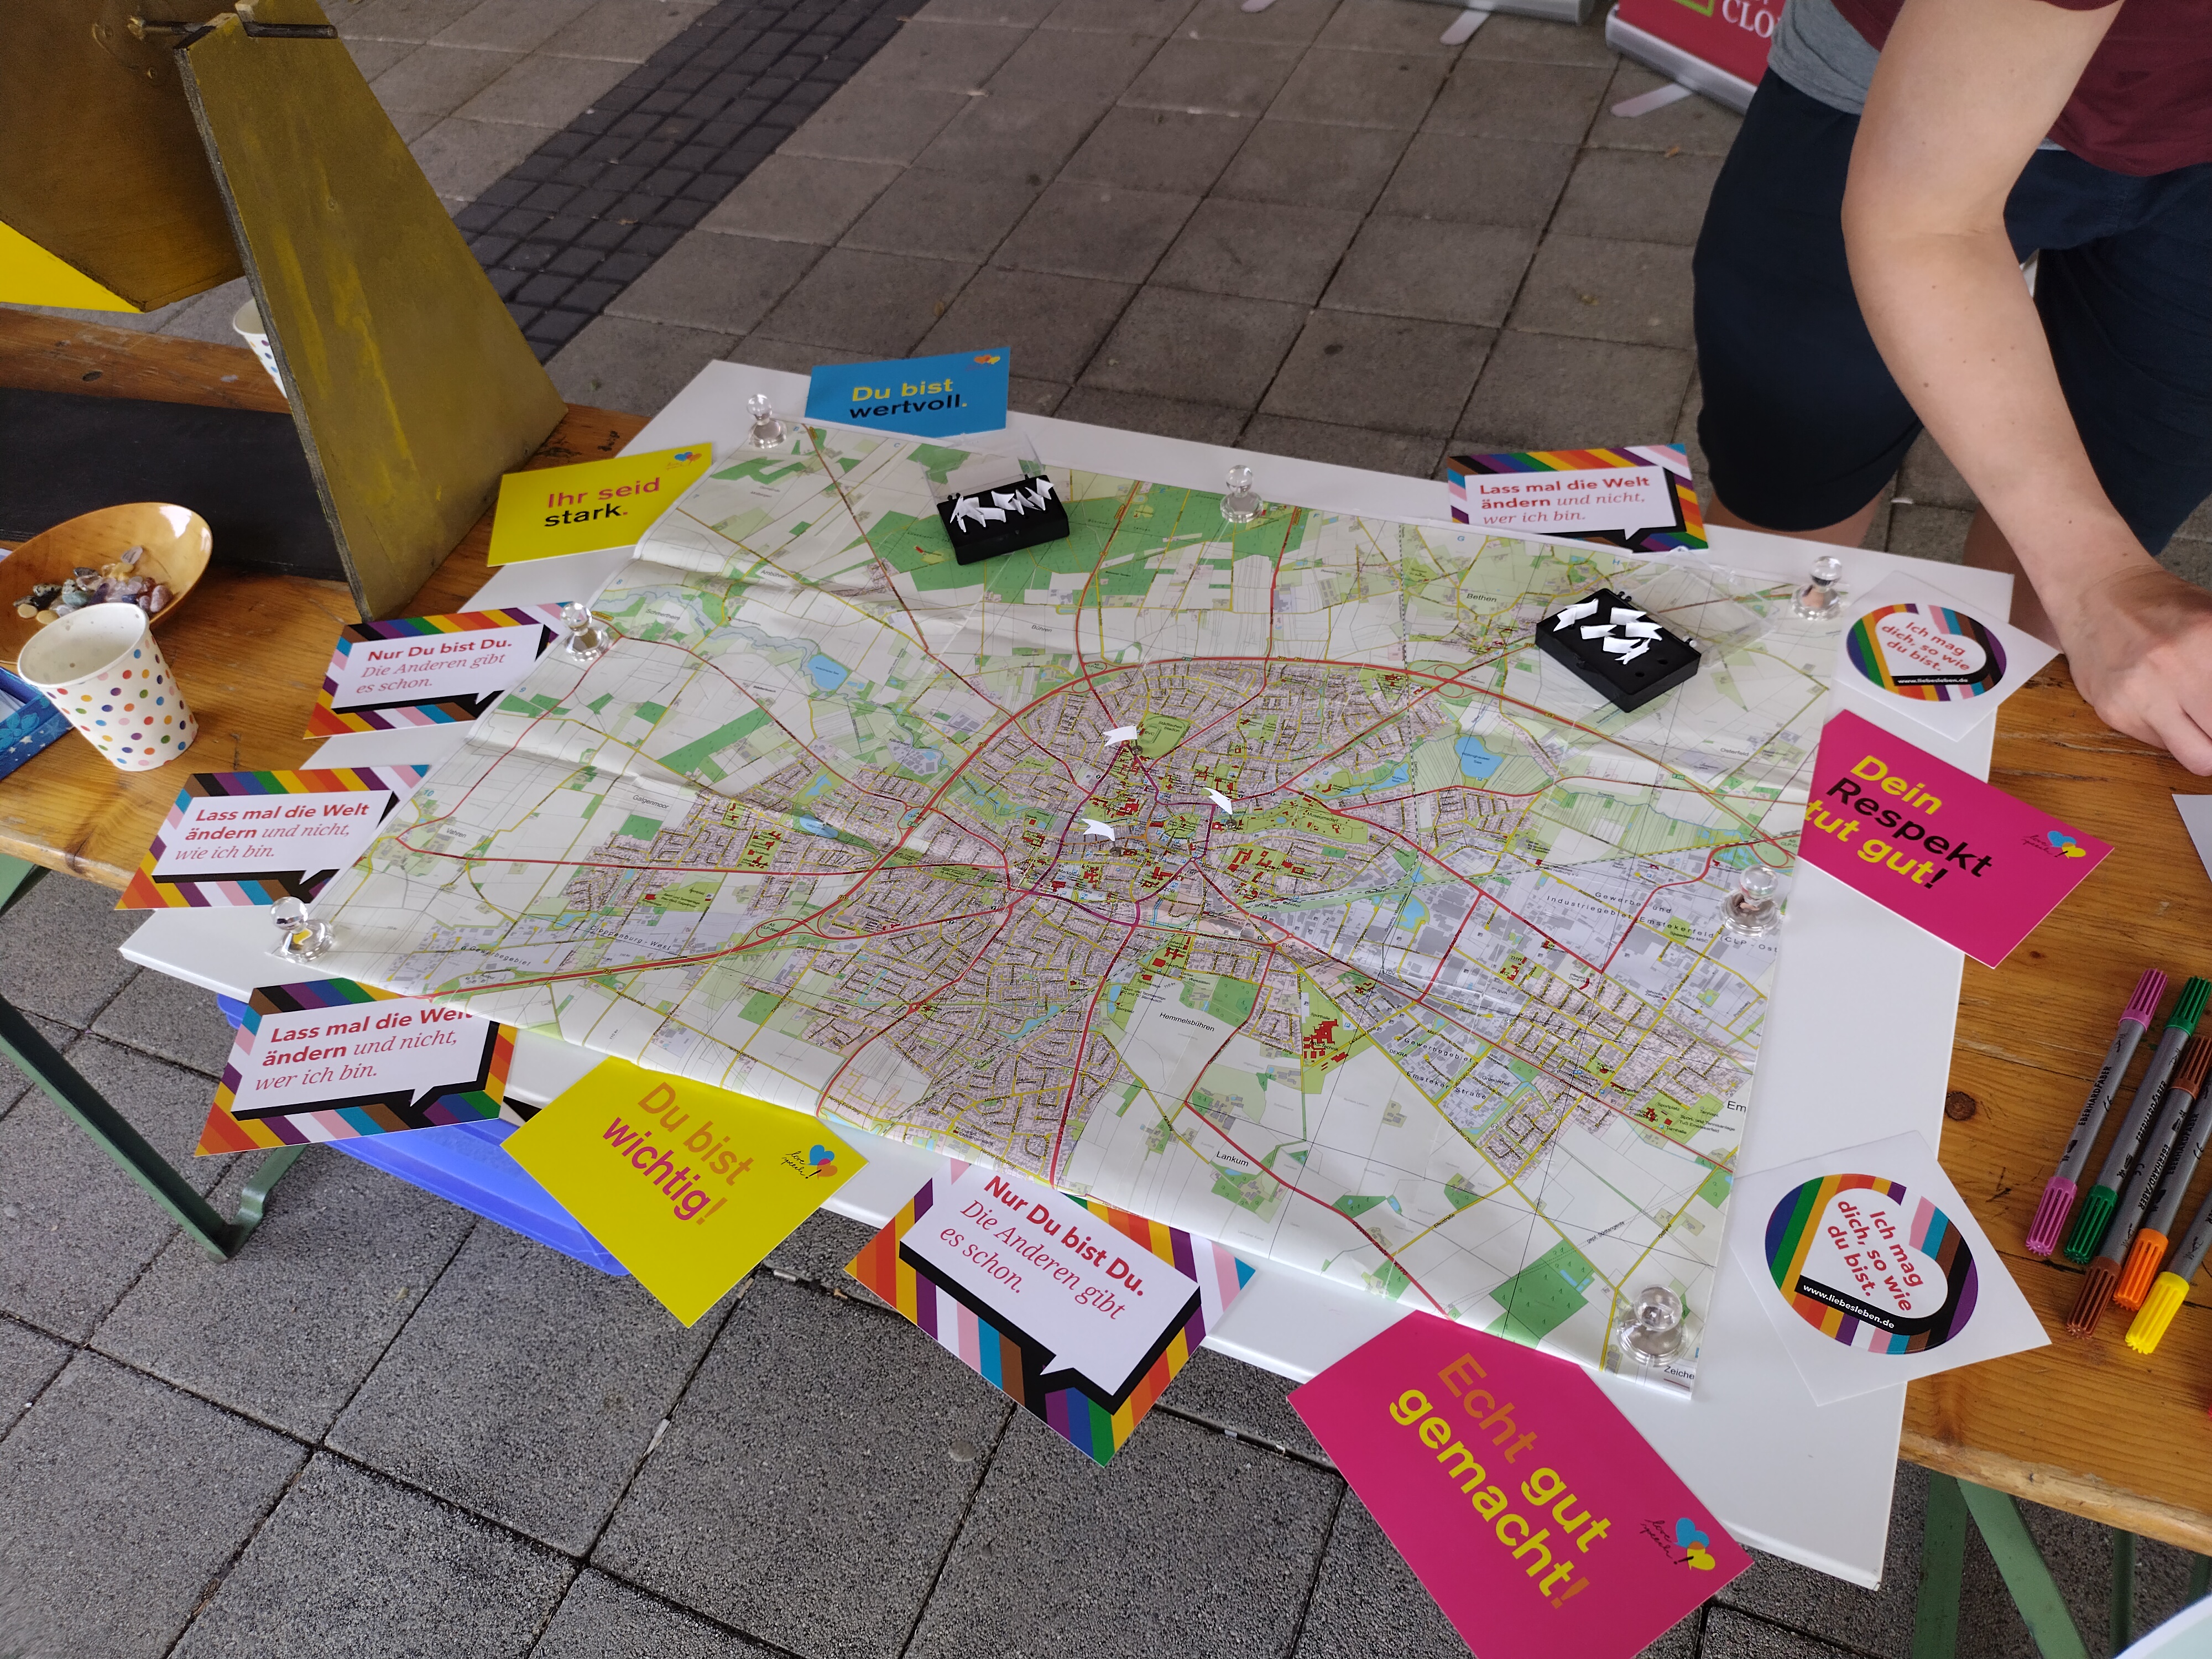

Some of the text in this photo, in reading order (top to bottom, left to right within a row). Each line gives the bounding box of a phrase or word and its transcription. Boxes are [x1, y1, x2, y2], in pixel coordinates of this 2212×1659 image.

[1722, 0, 1780, 38] CLO
[852, 378, 953, 401] Du bist
[850, 394, 967, 419] wertvoll.
[549, 477, 660, 508] Ihr seid
[1480, 476, 1650, 495] Lass mal die Welt
[1481, 492, 1645, 509] ändern und nicht,
[545, 503, 628, 526] stark.
[1484, 510, 1586, 525] wer ich bin.
[1466, 593, 1498, 603] Bethen
[368, 639, 512, 661] Nur Du bist Du.
[1882, 625, 1970, 670] dich, so wie
[1906, 622, 1965, 656] Ich mag
[361, 653, 505, 678] Die Anderen gibt
[1887, 641, 1942, 671] du bist.
[356, 677, 432, 694] es schon.
[1720, 748, 1750, 757] Osterfeld
[424, 789, 434, 797] 10
[1850, 755, 1942, 815] Dein
[196, 804, 369, 822] Lass mal die Welt
[633, 795, 670, 810] Galgenmoor
[1307, 811, 1339, 823] Museumsdorf
[1826, 777, 1993, 878] Respekt
[185, 823, 349, 841] ändern und nicht,
[446, 827, 467, 839] Vahren
[1804, 800, 1949, 889] tut gut!
[175, 844, 275, 860] wie ich bin.
[1547, 895, 1632, 920] Industriegebiet
[1639, 916, 1714, 939] Emstekerfeld
[1652, 905, 1672, 914] und
[590, 925, 671, 951] Cloppenburg West
[1670, 930, 1695, 942] Speedway
[470, 946, 532, 966] Gewerbegebiet
[271, 1027, 319, 1043] Lass
[326, 1015, 372, 1036] mal
[375, 1010, 413, 1029] die
[1160, 1012, 1215, 1032] Hemmelsbühren
[263, 1030, 457, 1067] ändern und nicht,
[1389, 1048, 1408, 1058] DEKRA
[1404, 1037, 1473, 1062] Gewerbegebiet
[255, 1063, 377, 1091] wer ich bin.
[1406, 1071, 1449, 1089] Emsteker
[1455, 1087, 1486, 1100] Straße
[1481, 1074, 1511, 1087] Gründerhof
[1656, 1102, 1681, 1112] Sportplatz
[2078, 1066, 2112, 1126] EBERHARDFABER
[638, 1081, 754, 1186] Du bist
[1689, 1122, 1720, 1133] Emstekerfeld
[785, 1150, 806, 1165] love
[1216, 1151, 1249, 1167] Lankum
[602, 1117, 728, 1225] wichtig!
[984, 1176, 1144, 1297] Nur Du bist Du.
[940, 1227, 1022, 1294] es schon.
[961, 1200, 1126, 1320] Die Anderen gibt
[1827, 1225, 1877, 1297] du bist.
[1838, 1200, 1912, 1311] dich, so wie
[1870, 1211, 1923, 1288] Ich mag
[1803, 1284, 1895, 1329] www.liebesleben.de
[1663, 1365, 1695, 1380] Zeiche
[1438, 1353, 1611, 1553] Echt gut
[1389, 1389, 1590, 1609] gemacht!
[1644, 1519, 1671, 1544] love
